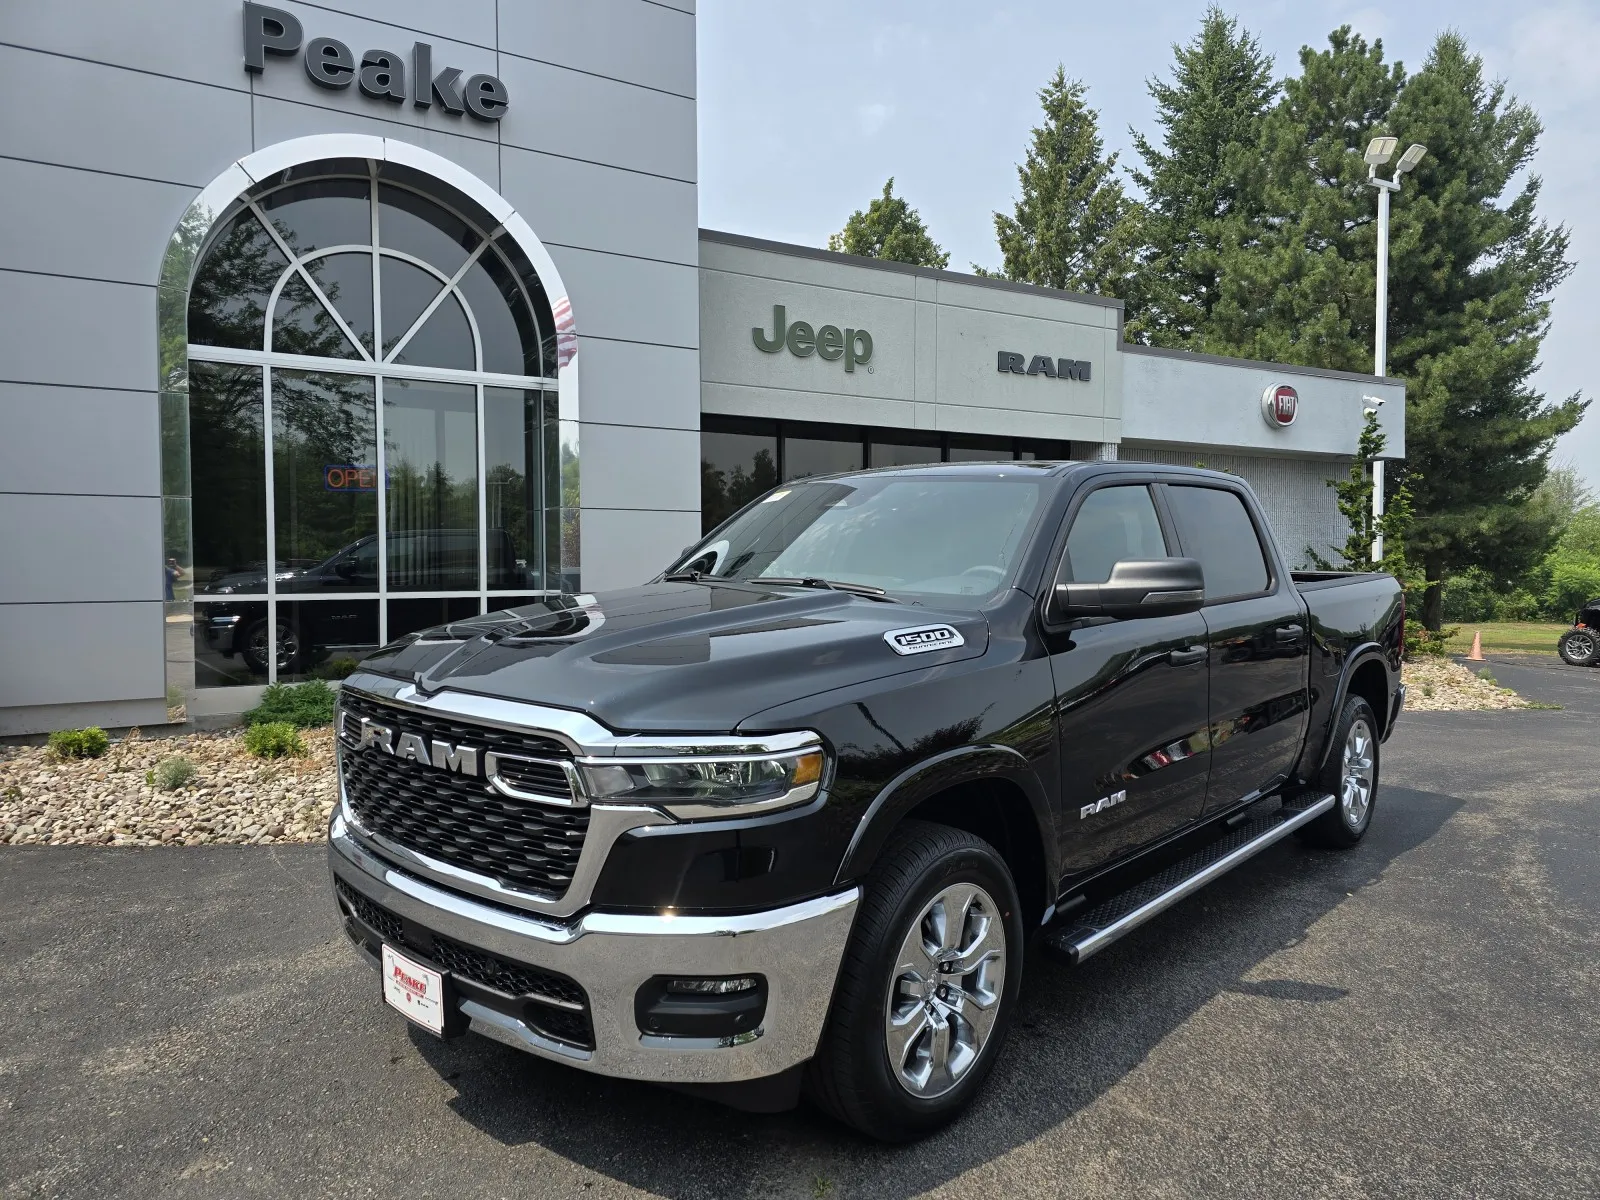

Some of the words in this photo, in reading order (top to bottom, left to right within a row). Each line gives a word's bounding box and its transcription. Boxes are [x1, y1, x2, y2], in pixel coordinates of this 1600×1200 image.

[243, 1, 509, 122] Peake
[752, 304, 874, 373] Jeep
[997, 350, 1092, 382] RAM
[1278, 395, 1295, 415] FIAT
[896, 629, 951, 646] 1500
[360, 717, 479, 777] RAM
[1080, 789, 1127, 820] RAM
[393, 965, 427, 995] PEAKE
